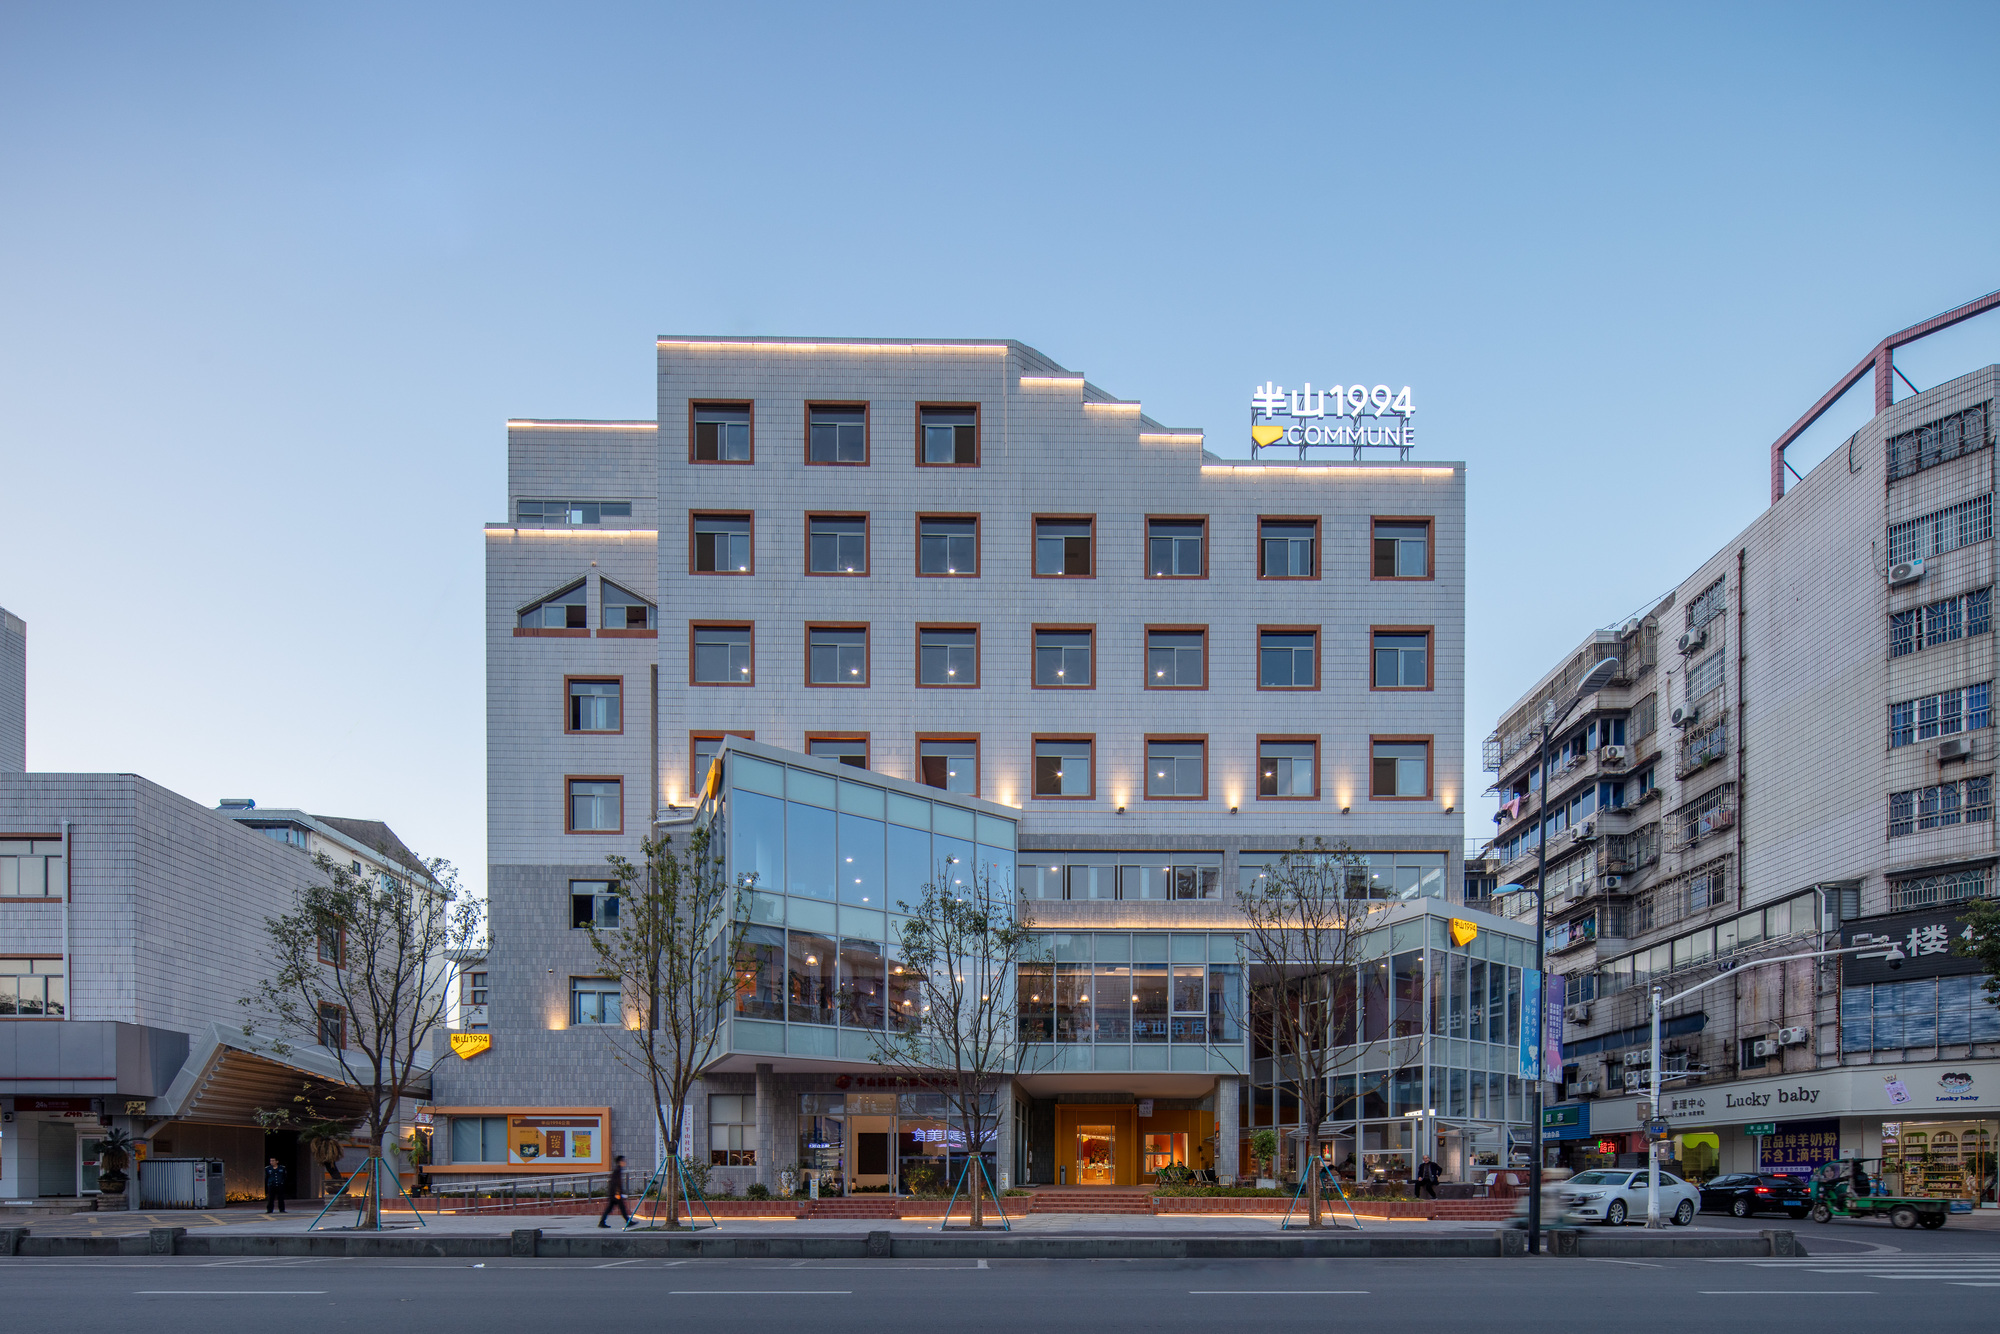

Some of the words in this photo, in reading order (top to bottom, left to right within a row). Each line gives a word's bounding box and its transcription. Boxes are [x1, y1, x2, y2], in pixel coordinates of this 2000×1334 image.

[1252, 381, 1416, 420] 半山1994
[1287, 425, 1415, 447] COMMUNE
[1134, 1020, 1205, 1035] 半山书店
[1726, 1092, 1771, 1109] Lucky
[1778, 1087, 1820, 1104] baby
[1761, 1147, 1837, 1163] 不含1滴牛乳
